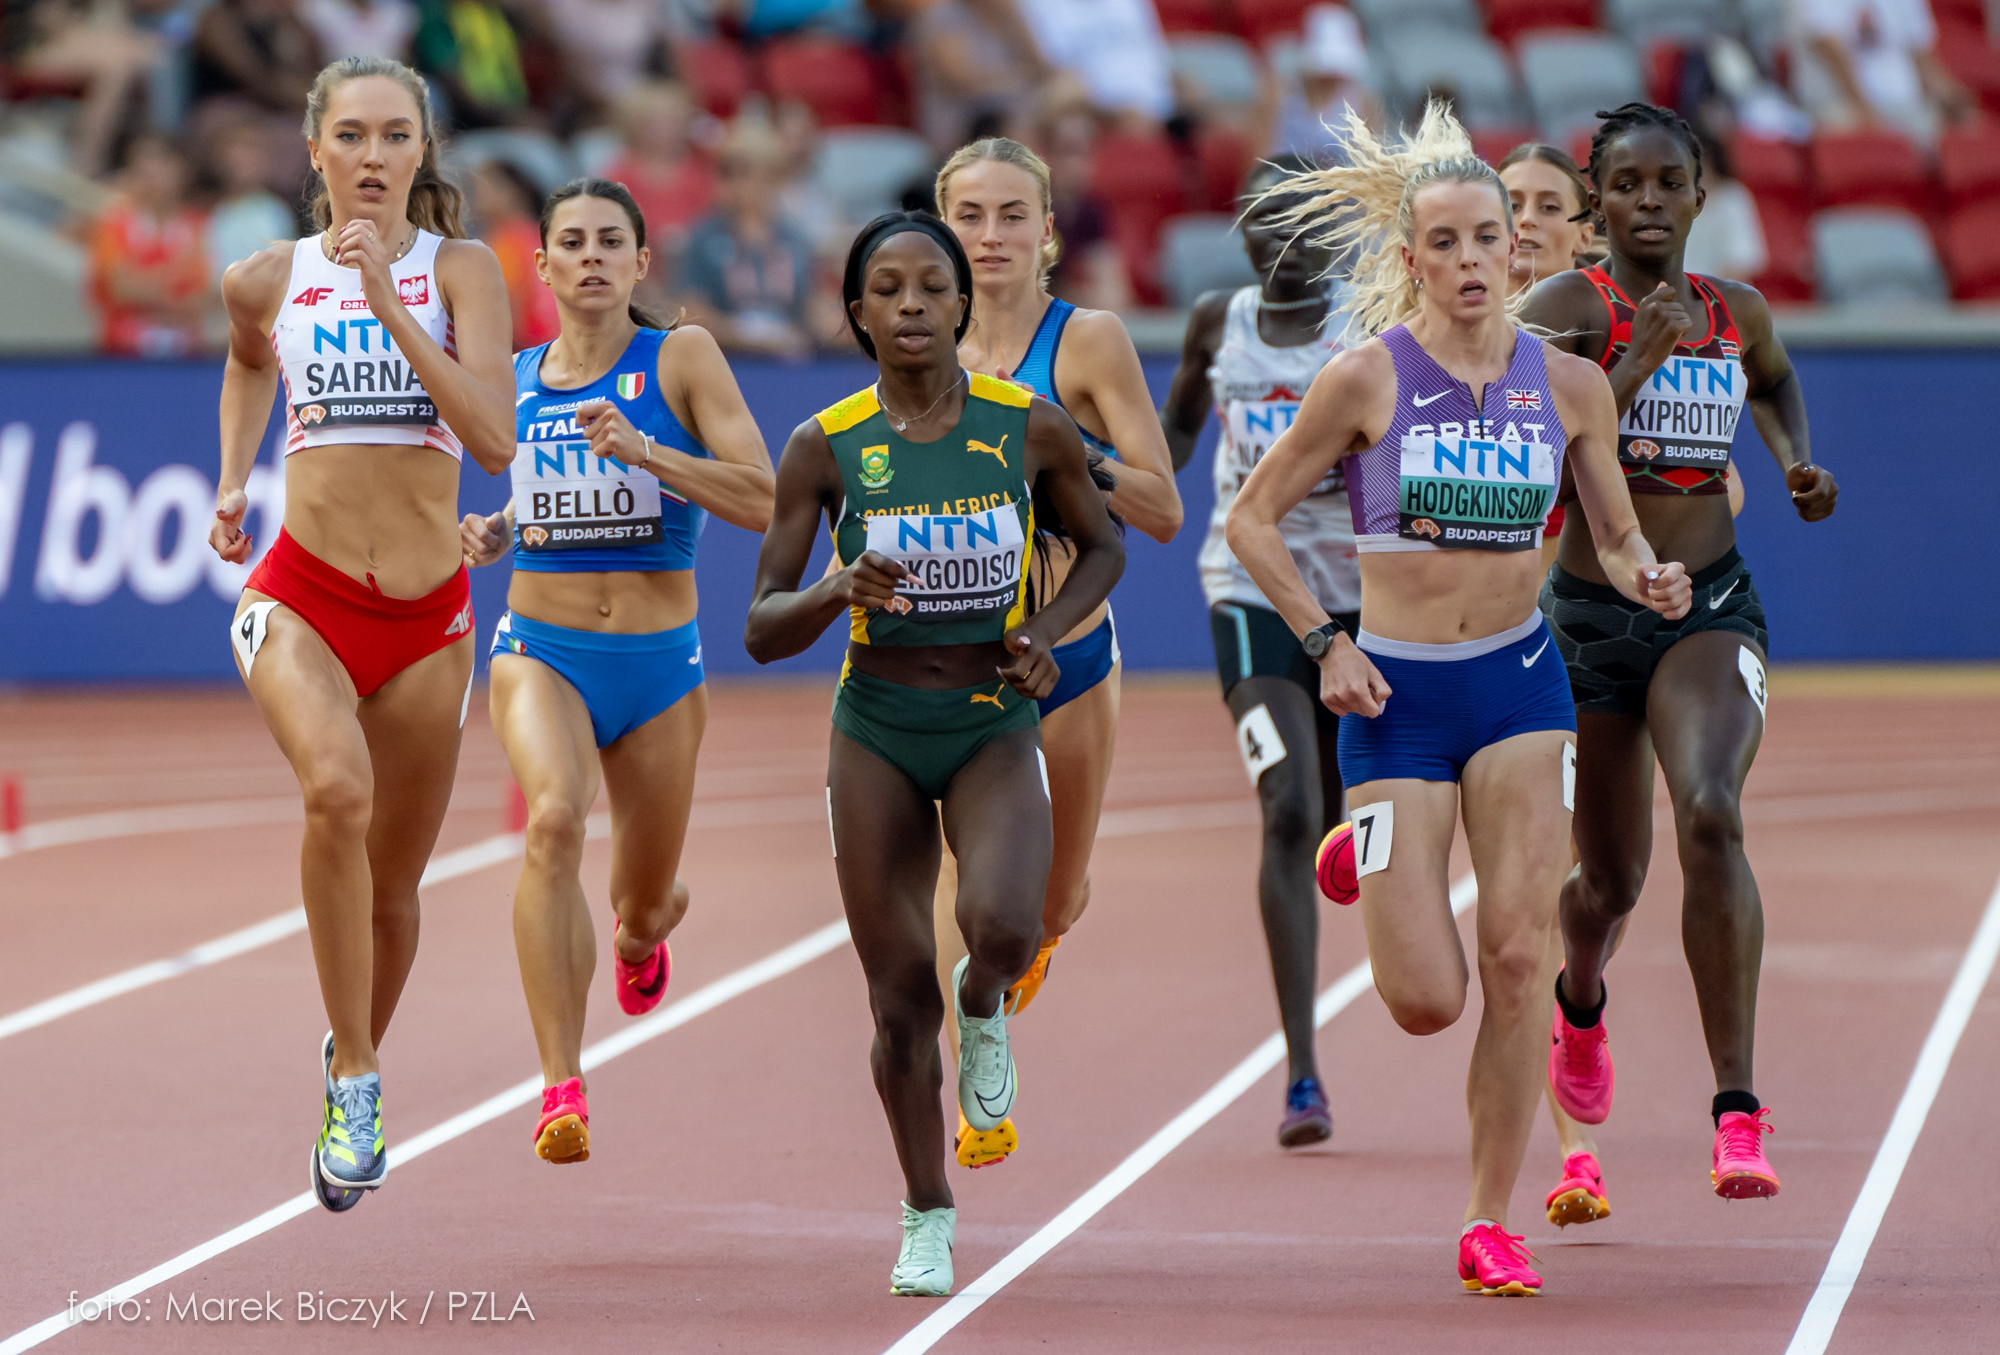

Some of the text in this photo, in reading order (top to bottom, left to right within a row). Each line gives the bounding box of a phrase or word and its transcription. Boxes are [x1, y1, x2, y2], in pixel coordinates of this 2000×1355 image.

[292, 287, 335, 307] 4F
[342, 301, 370, 310] ORL
[1652, 358, 1732, 398] NTN
[330, 404, 434, 417] BUDAPEST 23
[526, 417, 589, 441] ITAL
[1409, 419, 1546, 444] GREAT
[1434, 438, 1530, 480] NTN
[532, 481, 635, 521] BELLÒ
[1407, 480, 1547, 521] HODGKINSON
[552, 524, 653, 541] BUDAPEST 23
[898, 511, 999, 552] NTN
[1445, 527, 1531, 543] BUDAPEST 23
[917, 590, 1015, 613] BUDAPEST 23
[241, 610, 256, 655] 9
[1245, 725, 1263, 761] 4
[1359, 815, 1376, 866] 7
